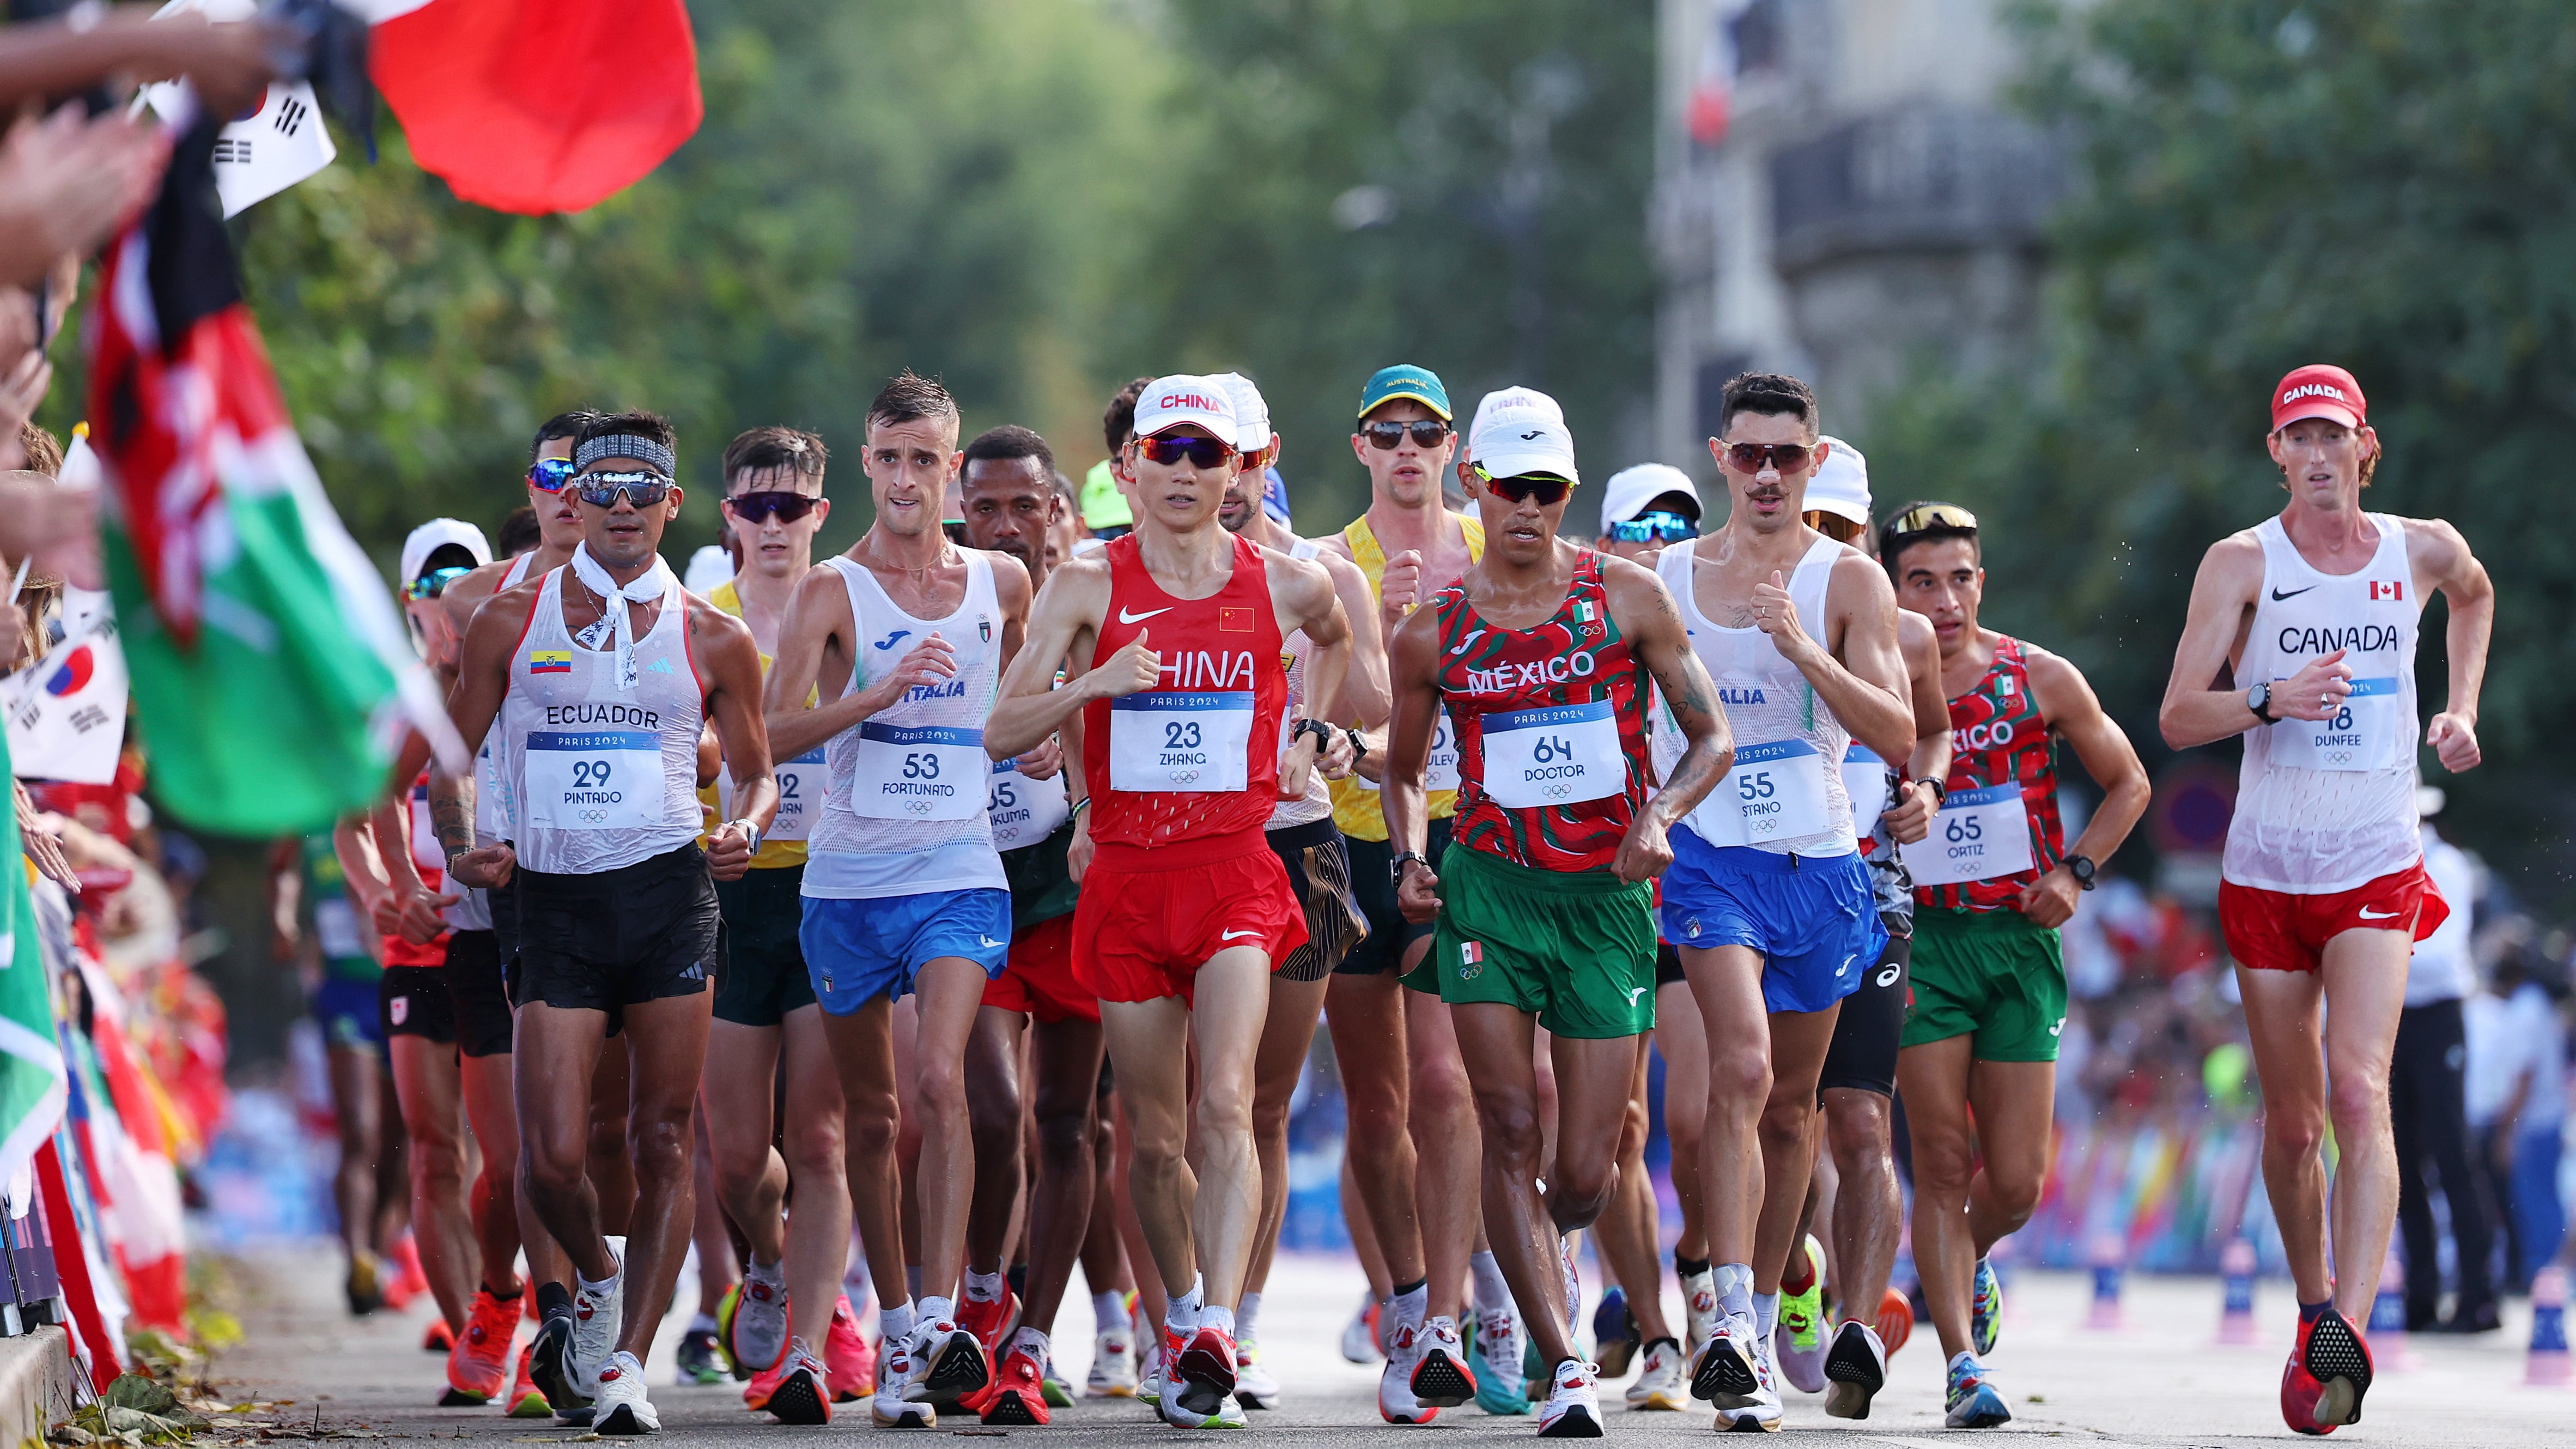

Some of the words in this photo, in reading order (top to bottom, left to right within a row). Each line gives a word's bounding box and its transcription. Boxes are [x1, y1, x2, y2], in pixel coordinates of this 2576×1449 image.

[1386, 378, 1429, 390] AUSTRALIA
[2283, 384, 2344, 404] CANADA
[1161, 394, 1220, 414] CHINA
[2280, 625, 2397, 654] CANADA
[1467, 651, 1594, 697] MÉXICO
[904, 682, 965, 702] ITALIA
[1151, 698, 1184, 706] PARIS
[1189, 697, 1218, 706] 2024
[546, 705, 659, 729] ECUADOR
[1514, 714, 1548, 724] PARIS
[1553, 710, 1583, 720] 2024
[558, 737, 591, 746] PARIS
[594, 736, 625, 745] 2024
[895, 731, 924, 740] PARIS
[927, 731, 955, 740] 2024
[1164, 722, 1201, 748] 23
[2316, 735, 2361, 747] DUNFEE
[1534, 736, 1572, 763] 64
[1754, 746, 1785, 757] 2024
[903, 753, 939, 779] 53
[1159, 753, 1206, 765] ZHANG
[573, 760, 611, 787] 29
[1524, 765, 1585, 781] DOCTOR
[882, 783, 955, 797] FORTUNATO
[1740, 772, 1774, 800] 55
[564, 791, 622, 804] PINTADO
[1963, 792, 1991, 803] 2024
[1742, 802, 1781, 817] STANO
[1946, 816, 1982, 843] 65
[1948, 844, 1984, 859] ORTIZ
